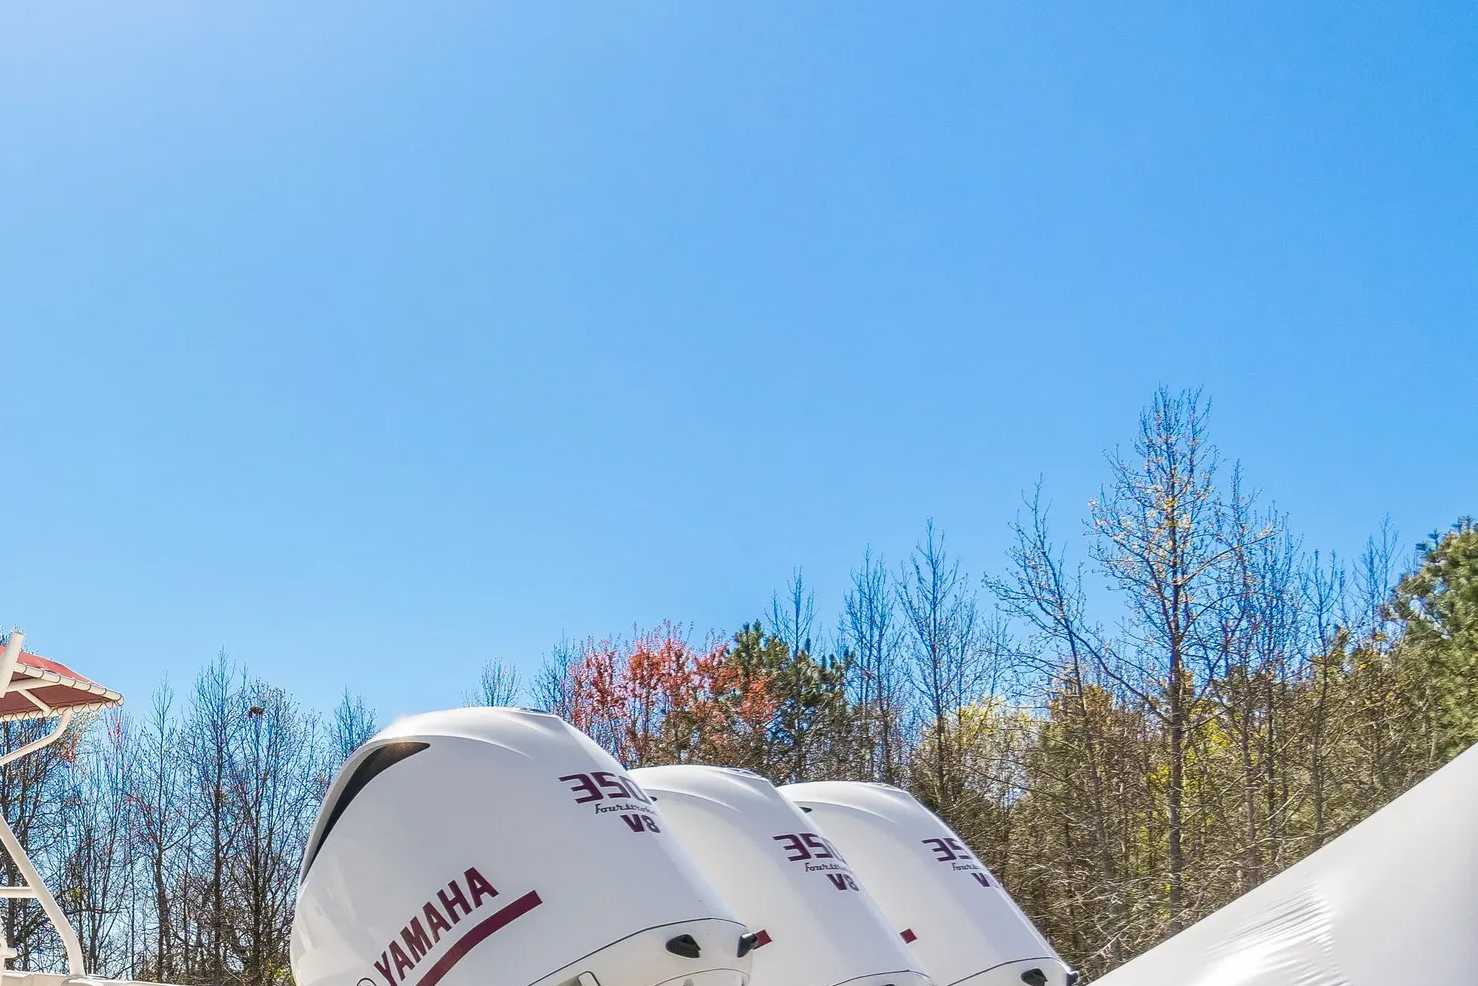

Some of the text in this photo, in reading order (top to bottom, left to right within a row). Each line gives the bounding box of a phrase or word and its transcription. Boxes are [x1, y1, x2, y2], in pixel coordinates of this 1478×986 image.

[558, 771, 652, 805] 350
[620, 813, 661, 833] V8
[921, 837, 973, 861] 35
[825, 873, 860, 891] V8
